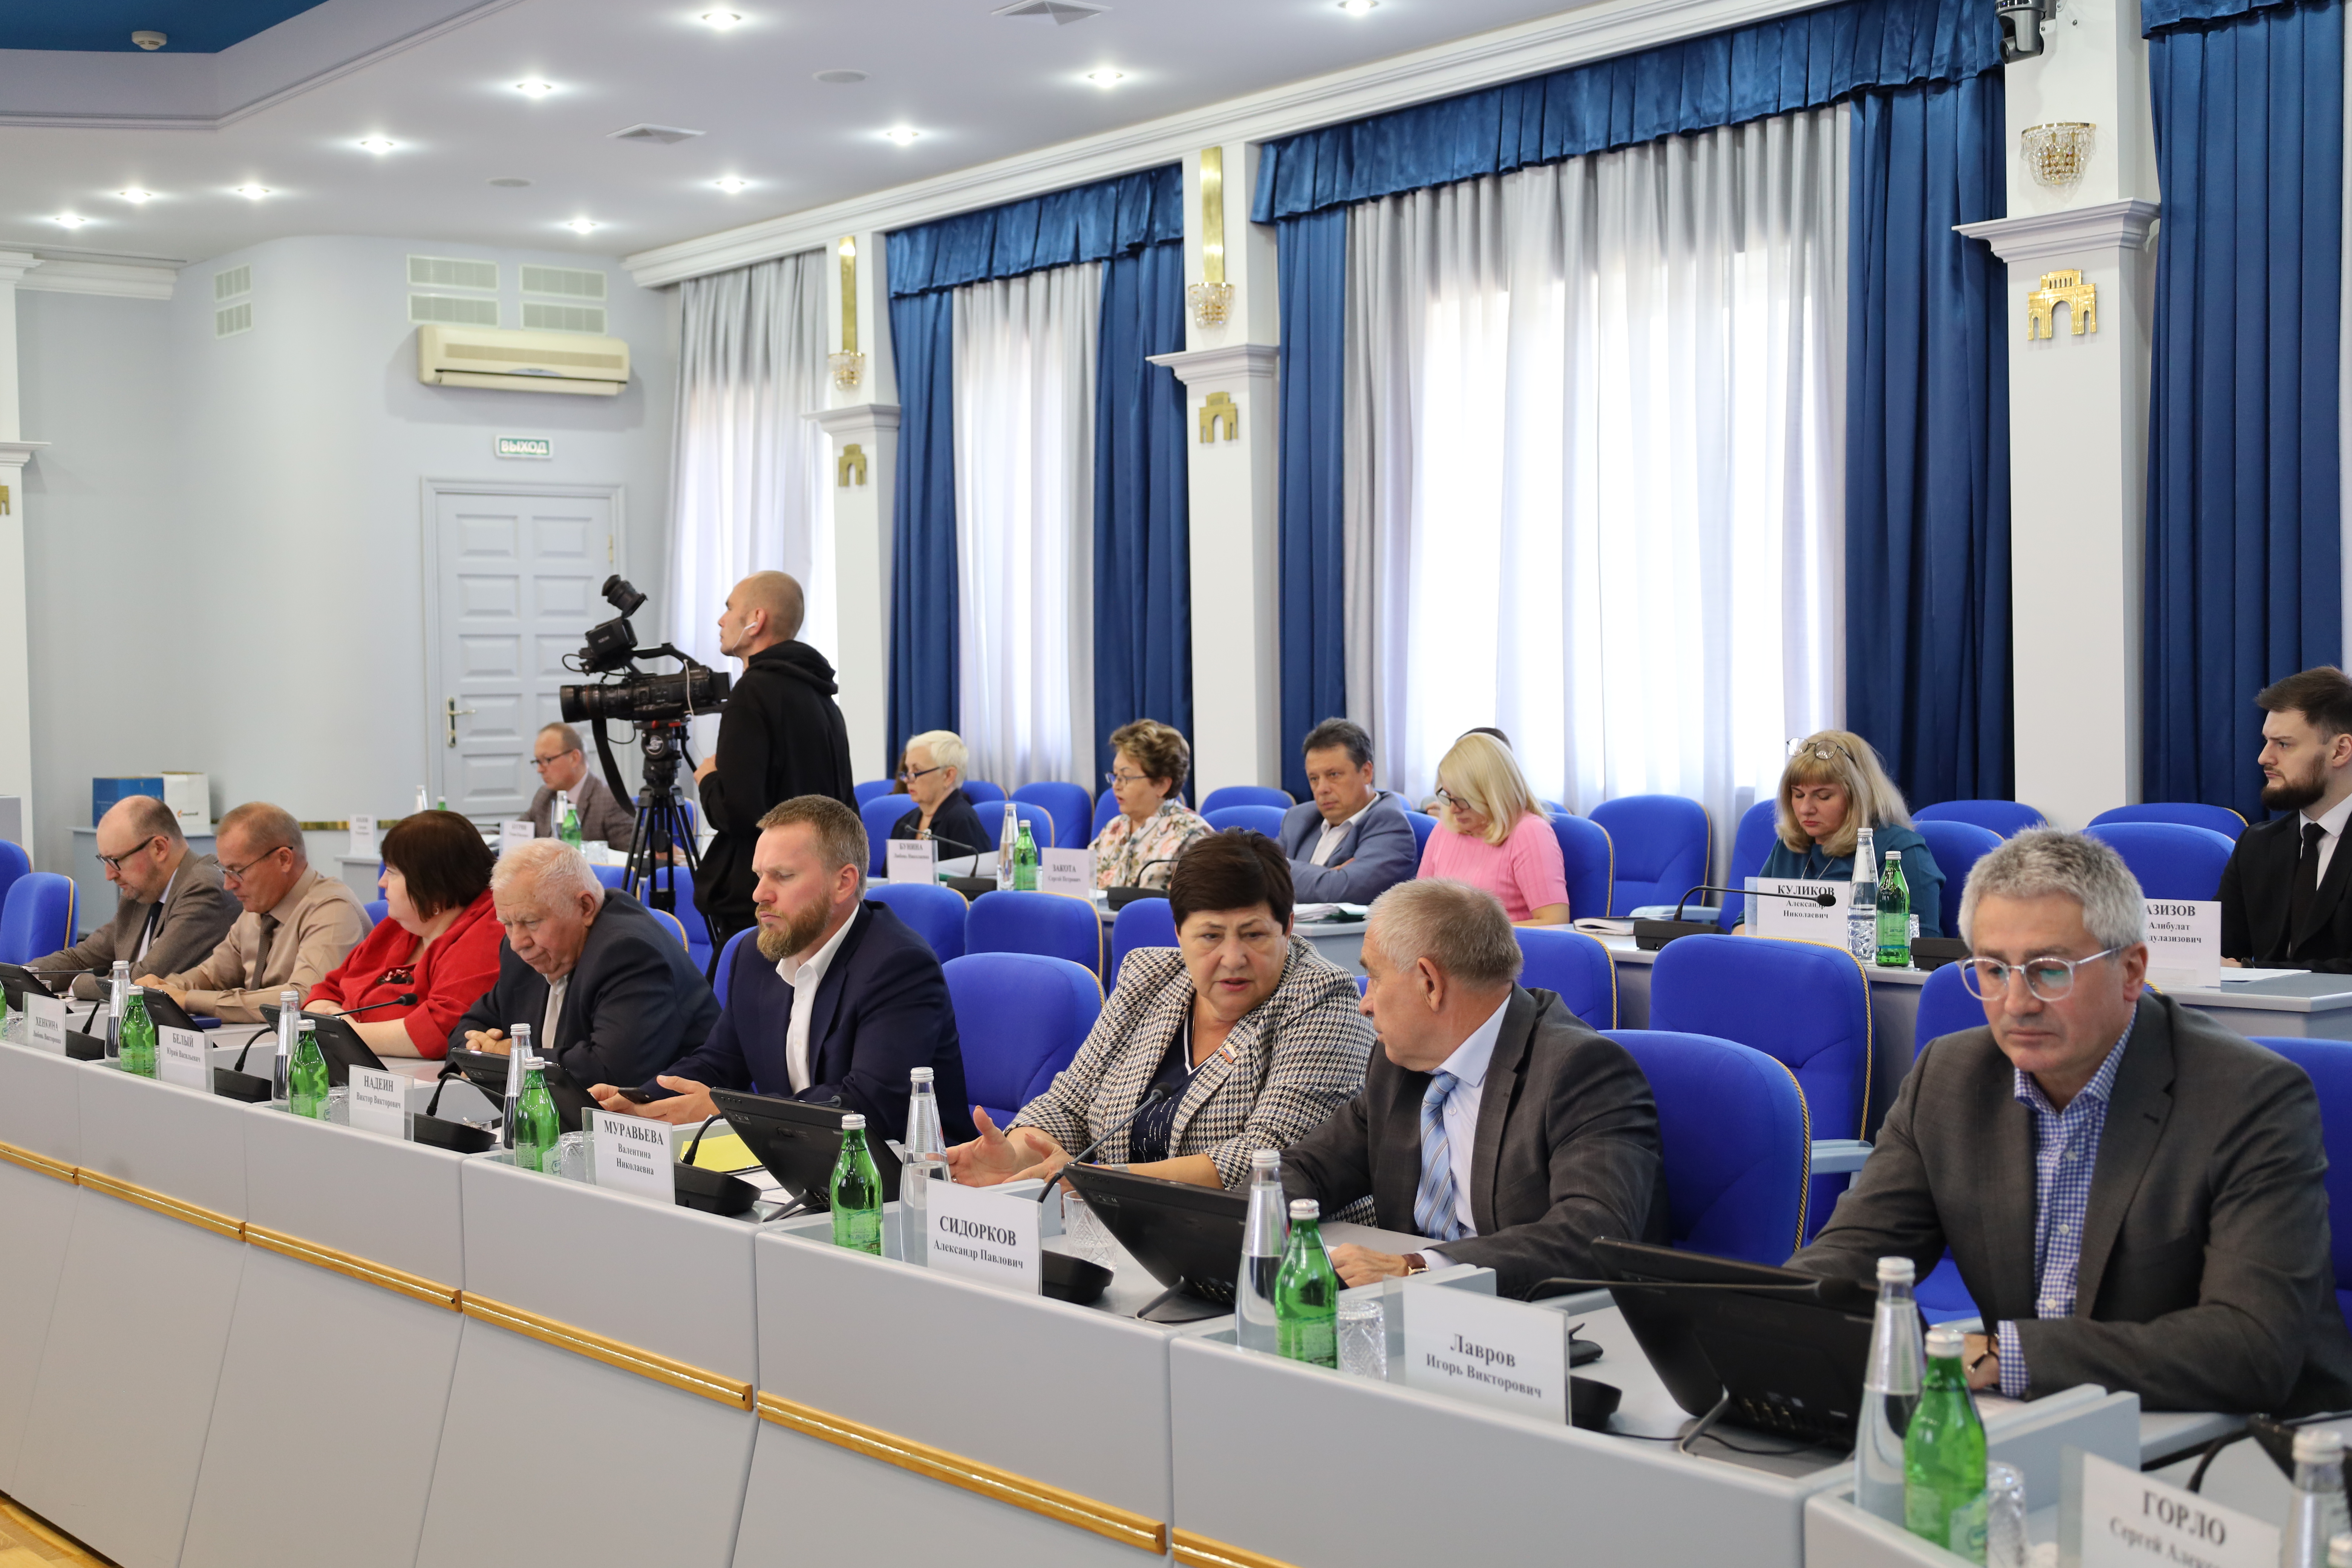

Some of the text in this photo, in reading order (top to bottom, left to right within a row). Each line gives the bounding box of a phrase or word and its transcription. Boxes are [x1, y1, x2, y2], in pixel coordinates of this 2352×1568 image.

[501, 440, 547, 454] ВЫХОД
[1053, 864, 1076, 872] ЗАКОТА
[1778, 885, 1834, 896] КУЛИКОВ
[1784, 910, 1828, 918] Николаевич
[2148, 922, 2190, 931] Алибулат
[2146, 934, 2202, 943] дулазизович
[36, 1016, 58, 1031] ХЕНКИНА
[173, 1033, 193, 1047] БЕЛЫЙ
[167, 1047, 201, 1063] Юрий Васильевич
[364, 1075, 394, 1092] НАДЕИН
[357, 1092, 401, 1109] Виктор Викторович
[604, 1119, 664, 1145] МУРАВЬЕВА
[618, 1143, 651, 1159] Валентина
[616, 1157, 654, 1175] Николаевна
[940, 1216, 1016, 1246] СИДОРКОВ
[934, 1239, 1023, 1269] Александр Павлович
[1450, 1333, 1516, 1367] Лавров
[1426, 1353, 1542, 1398] Игорь Викторович
[2144, 1490, 2226, 1546] ГОРЛО
